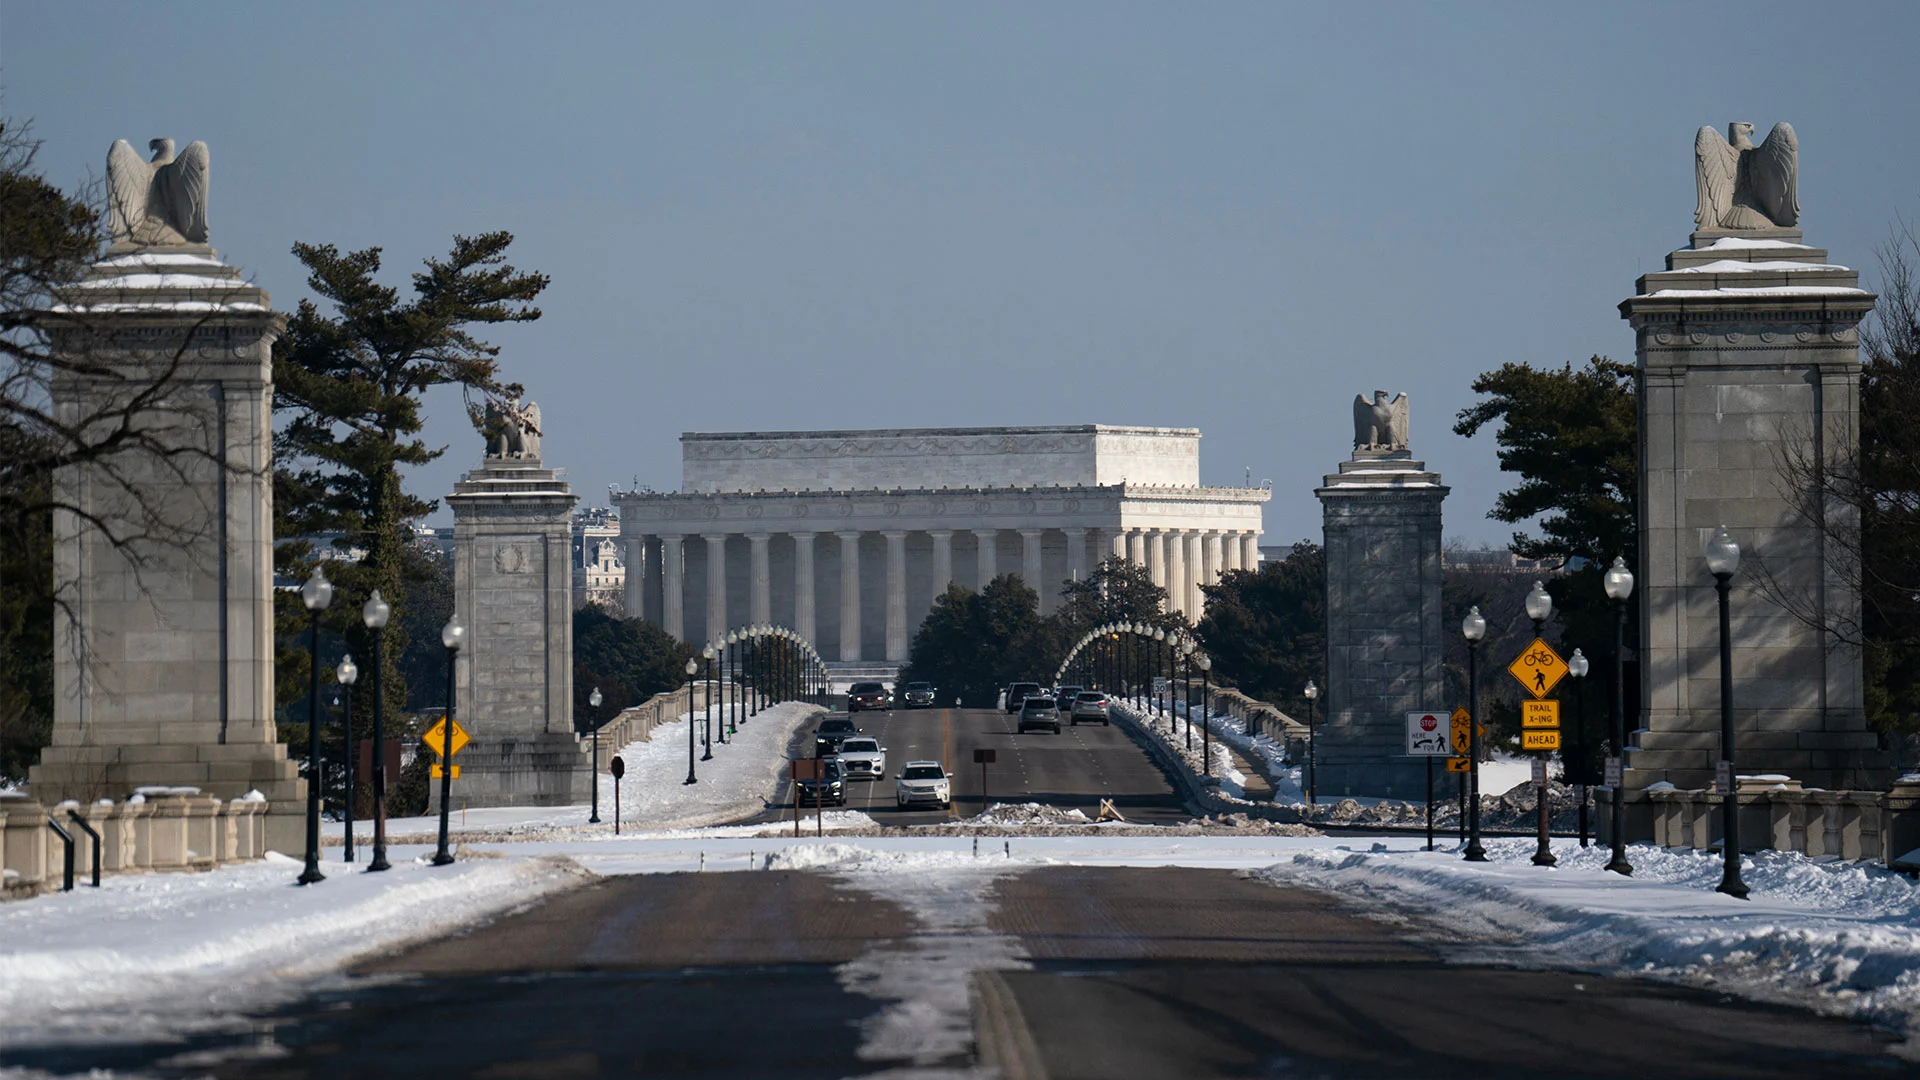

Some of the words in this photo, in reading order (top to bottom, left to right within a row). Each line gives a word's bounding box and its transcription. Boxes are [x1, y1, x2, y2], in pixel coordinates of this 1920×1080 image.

[1420, 719, 1437, 727] STOP
[1529, 715, 1552, 723] X-ING
[1527, 735, 1555, 744] AHEAD
